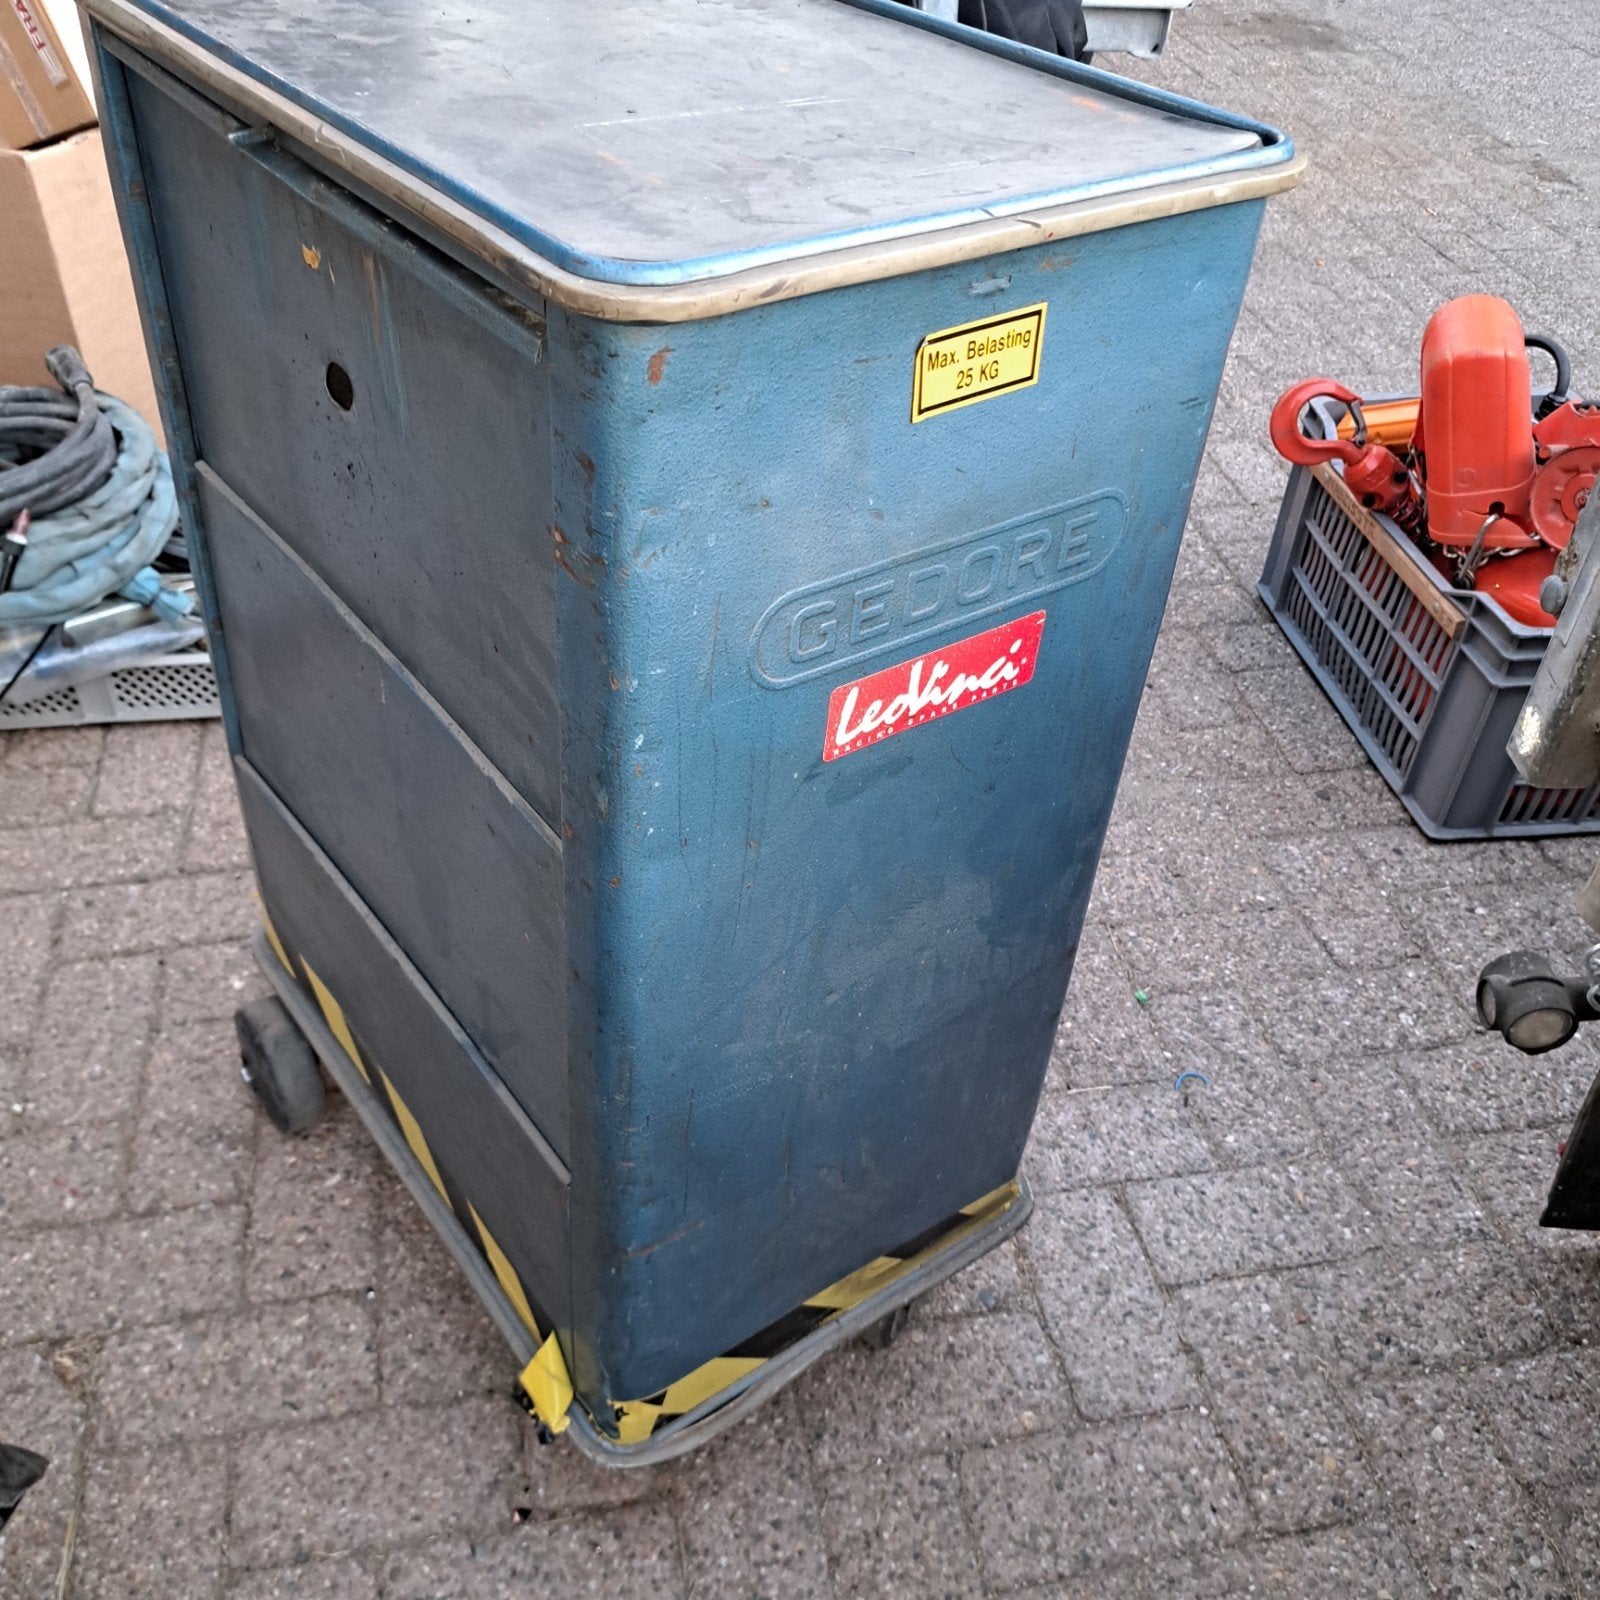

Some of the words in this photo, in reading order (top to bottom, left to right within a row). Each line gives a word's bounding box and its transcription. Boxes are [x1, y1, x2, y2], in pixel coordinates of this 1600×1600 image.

[927, 350, 960, 372] Max.
[967, 329, 1032, 360] Belasting
[956, 367, 974, 390] 25
[979, 360, 999, 383] KG
[789, 510, 1099, 664] GEDORE
[833, 726, 894, 756] RACING
[907, 702, 958, 726] SPARE
[971, 679, 1018, 702] PARTS
